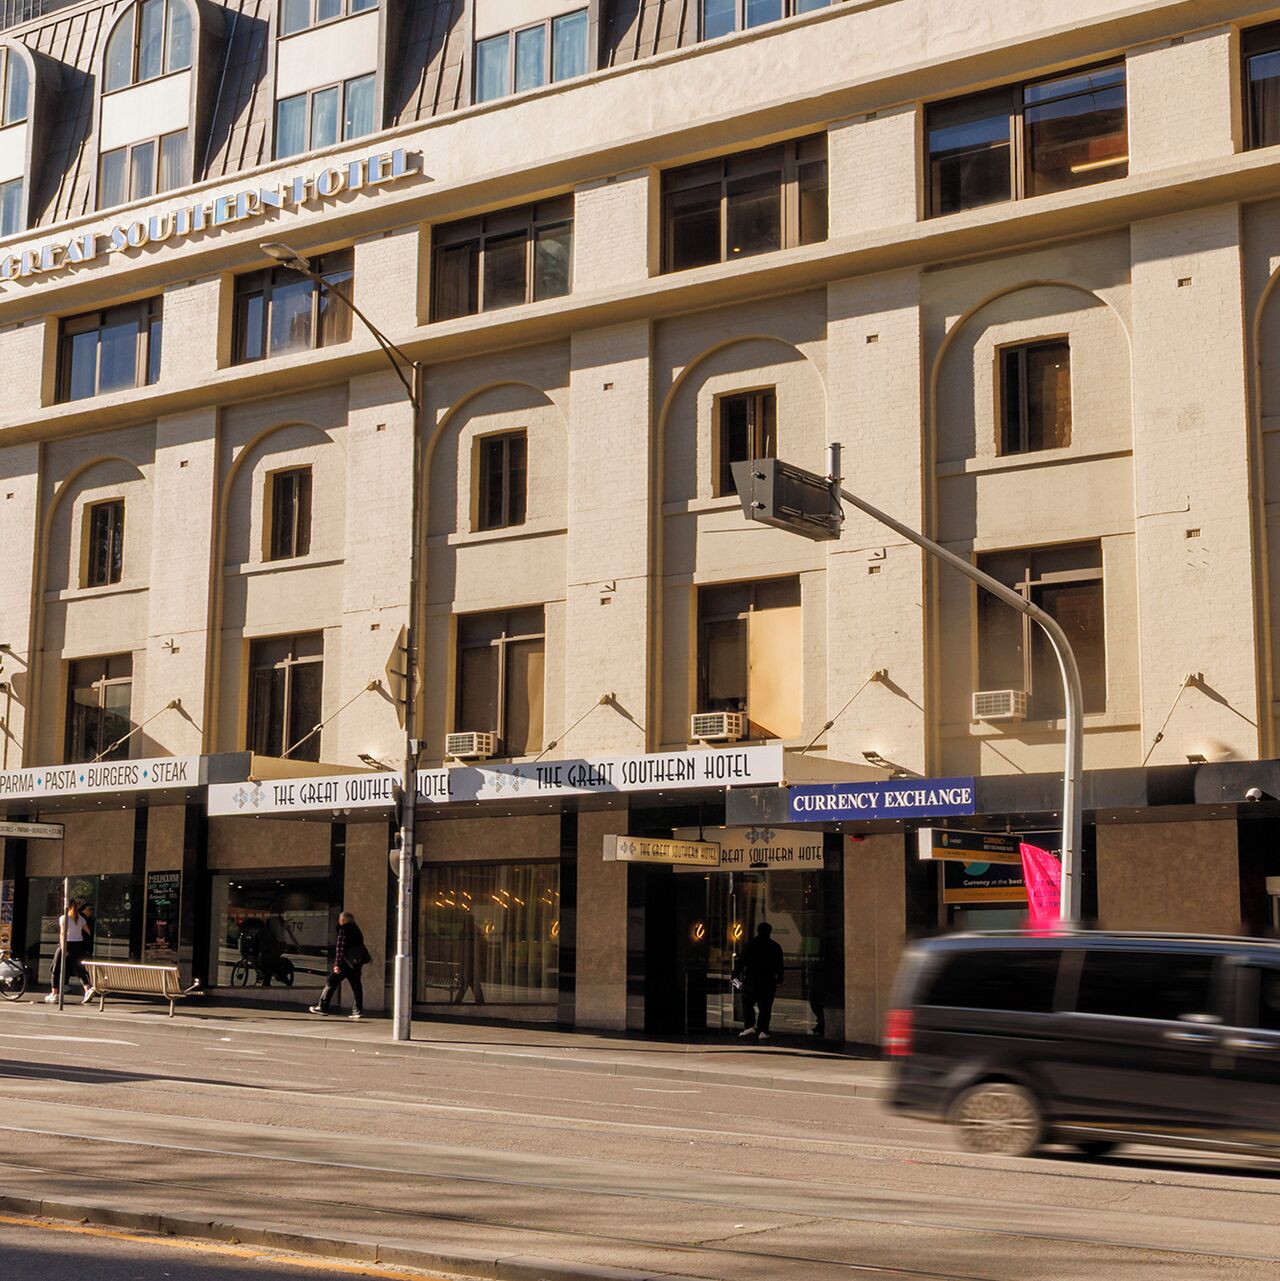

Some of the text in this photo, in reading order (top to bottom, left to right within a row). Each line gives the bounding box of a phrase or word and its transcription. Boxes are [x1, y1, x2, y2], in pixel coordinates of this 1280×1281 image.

[106, 181, 288, 253] SOUTHERN
[293, 148, 419, 204] HOTEL
[0, 773, 35, 793] PARMA
[45, 770, 77, 791] PASTA
[87, 765, 139, 788] BURGERS
[151, 761, 188, 783] STEAK
[536, 753, 752, 790] THE GREAT SOUTHERN HOTEL
[273, 784, 296, 806] THE
[300, 781, 339, 804] GREAT
[793, 787, 972, 811] CURRENCY EXCHANGE
[640, 842, 717, 860] THE GREAT SOUTHERN HOTEL
[721, 845, 824, 863] REAT SOUTHERN HOTE
[963, 879, 990, 887] Currency
